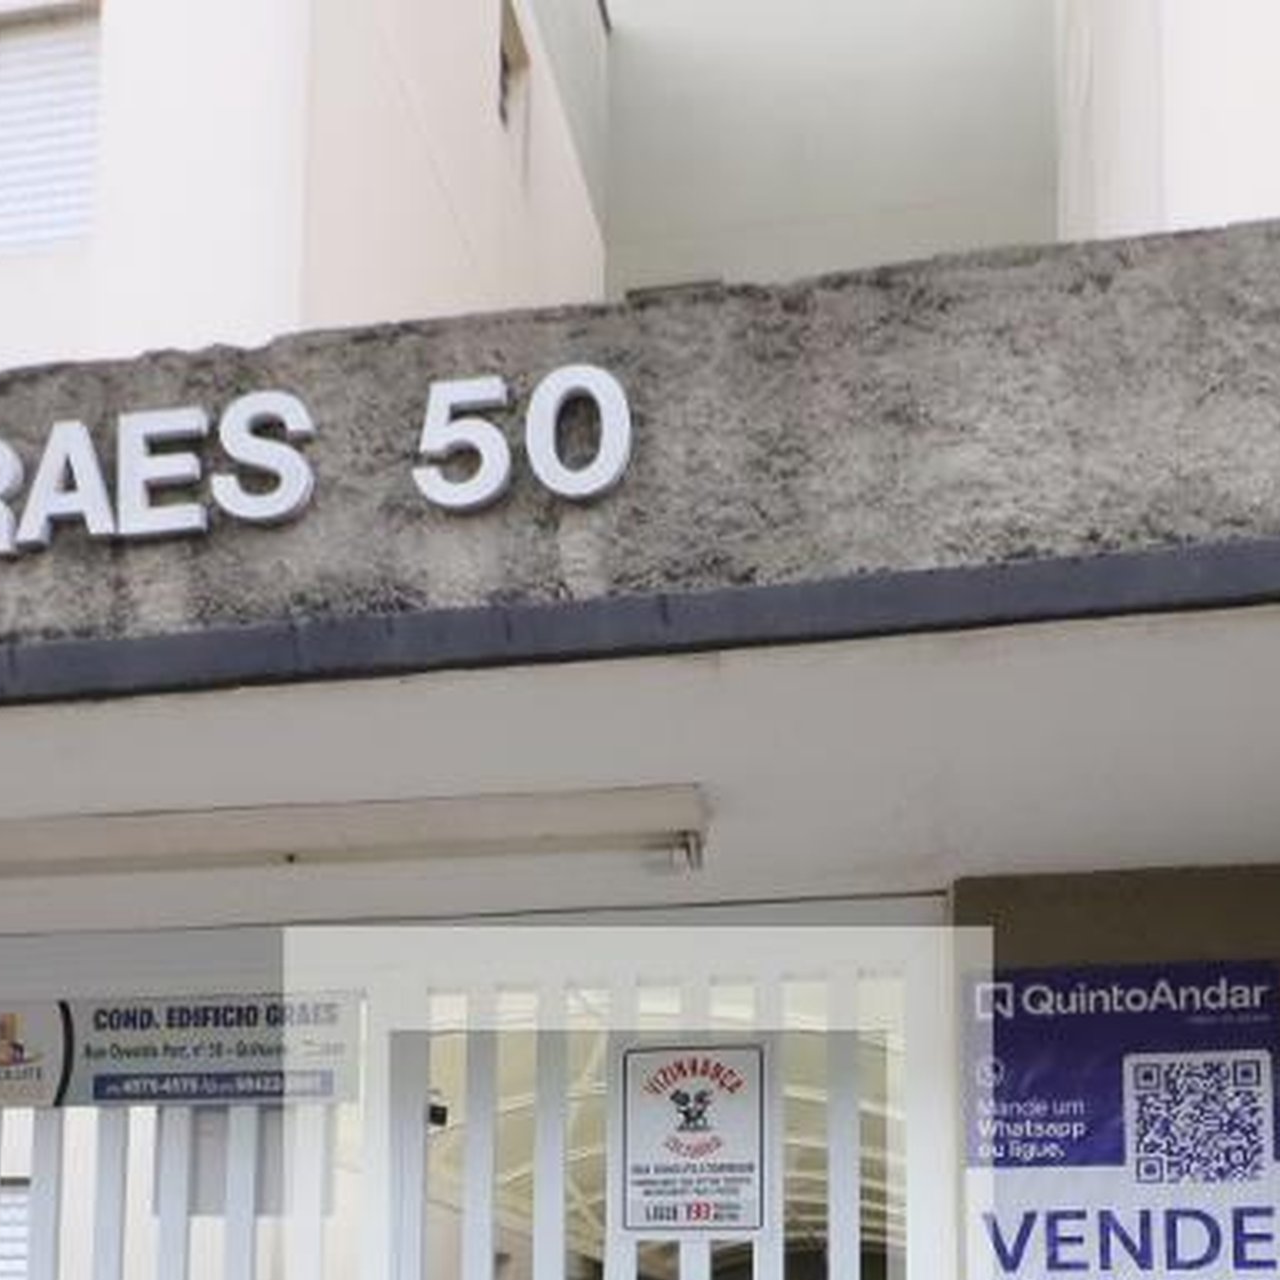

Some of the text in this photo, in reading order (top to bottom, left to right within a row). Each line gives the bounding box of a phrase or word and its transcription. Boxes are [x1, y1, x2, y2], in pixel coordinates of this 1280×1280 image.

[410, 362, 635, 515] 50
[1021, 979, 1268, 1016] QuintoAndar
[93, 1007, 160, 1032] COND.
[1051, 1099, 1085, 1116] um
[978, 1119, 1086, 1141] Whatsapp
[979, 1142, 1005, 1158] ou
[983, 1206, 1277, 1272] VENDE
